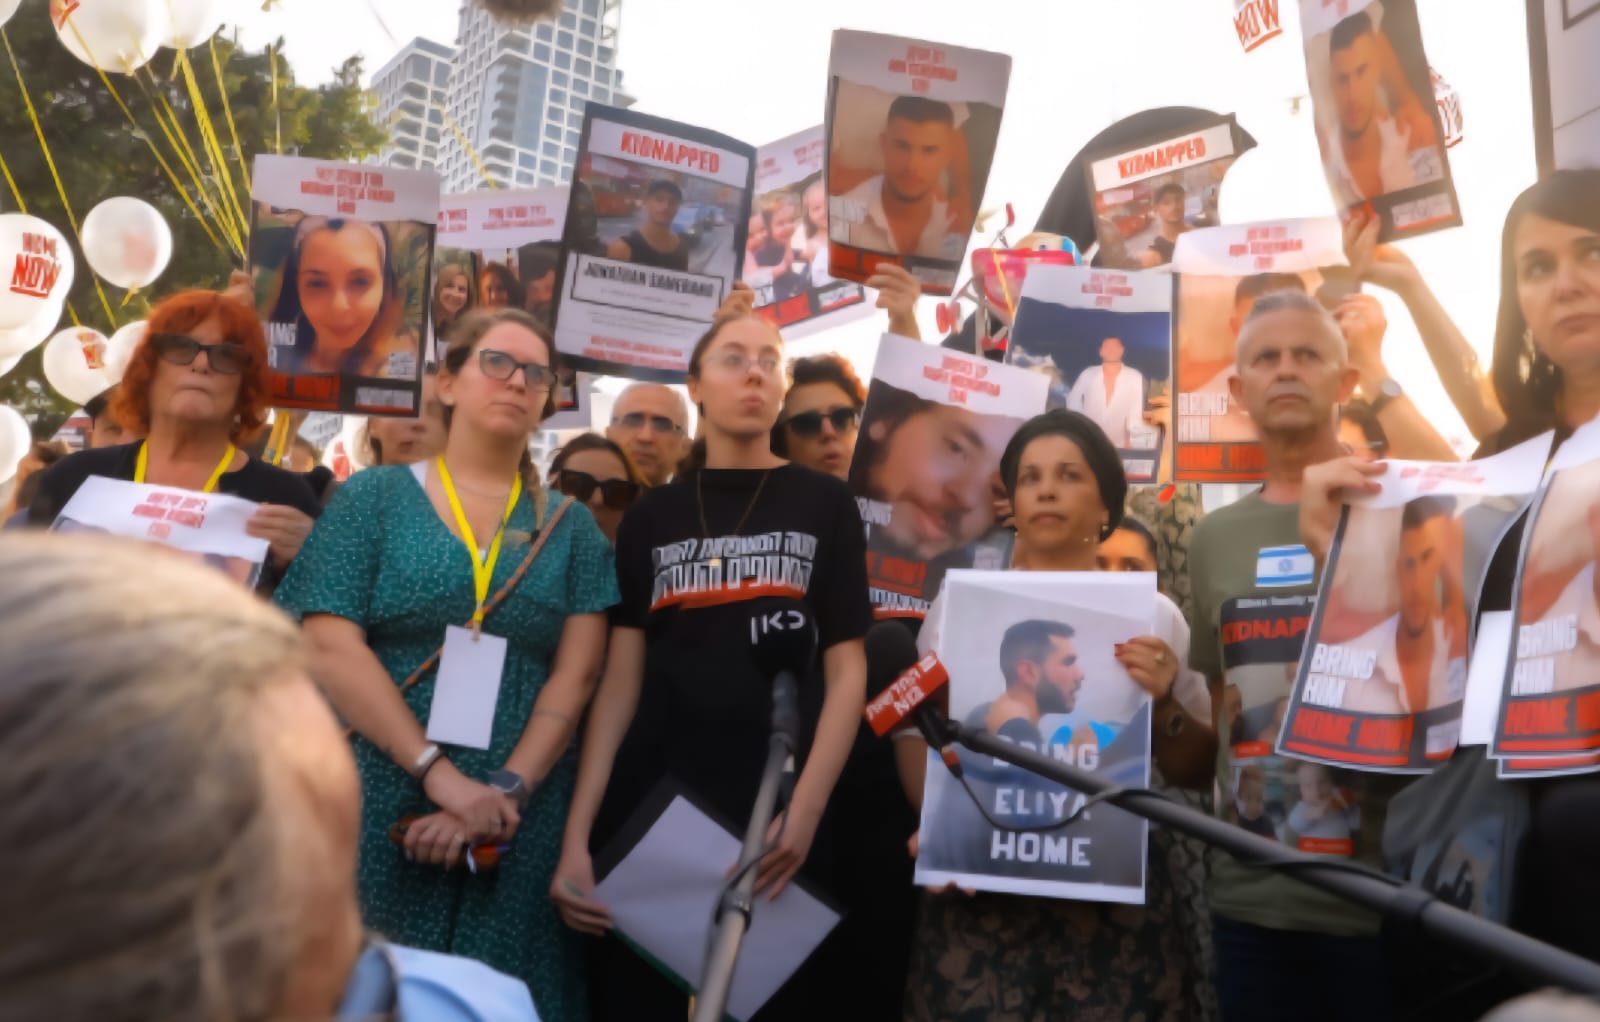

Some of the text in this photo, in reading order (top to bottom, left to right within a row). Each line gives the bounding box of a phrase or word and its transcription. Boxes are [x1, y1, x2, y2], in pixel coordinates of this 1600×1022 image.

[620, 131, 720, 174] KIDNAPPED
[1117, 137, 1206, 179] KIDNAPPED
[11, 253, 61, 292] NOW
[751, 610, 806, 645] כאן
[993, 734, 1099, 772] ING
[994, 788, 1092, 820] ELIYA
[990, 829, 1091, 867] HOME
